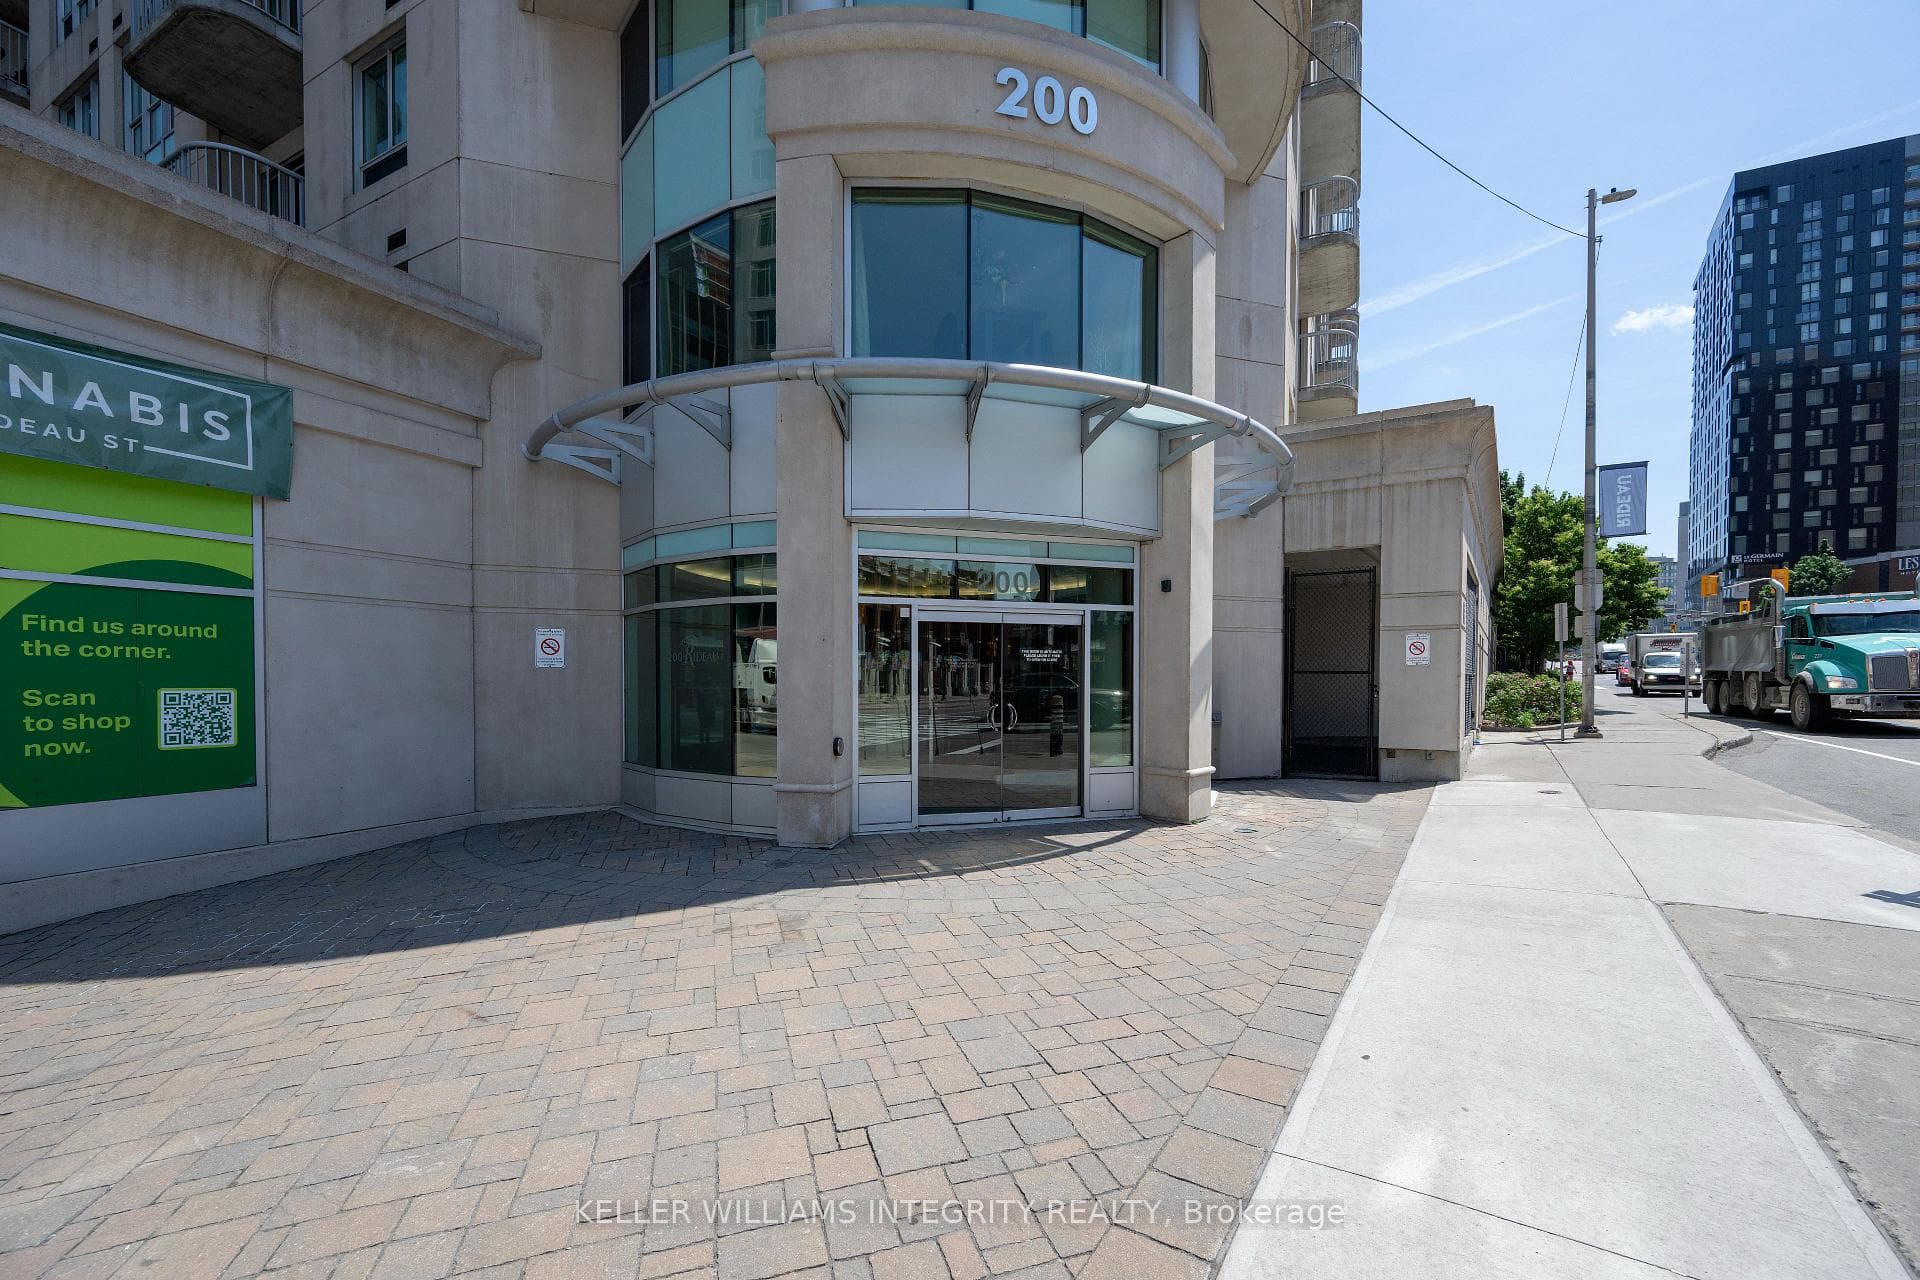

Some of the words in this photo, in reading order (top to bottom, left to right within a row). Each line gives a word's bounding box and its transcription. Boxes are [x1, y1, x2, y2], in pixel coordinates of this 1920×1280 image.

[994, 67, 1098, 135] 200
[9, 363, 231, 441] NABIS
[103, 434, 139, 453] ST
[1898, 556, 1919, 571] LES
[976, 569, 1028, 595] 200
[22, 613, 84, 633] Find
[93, 620, 124, 635] us
[131, 623, 218, 639] around
[21, 639, 71, 657] the
[79, 644, 171, 659] corner.
[22, 689, 96, 707] Scan
[23, 715, 54, 731] to
[62, 713, 131, 732] shop
[24, 741, 91, 757] now.
